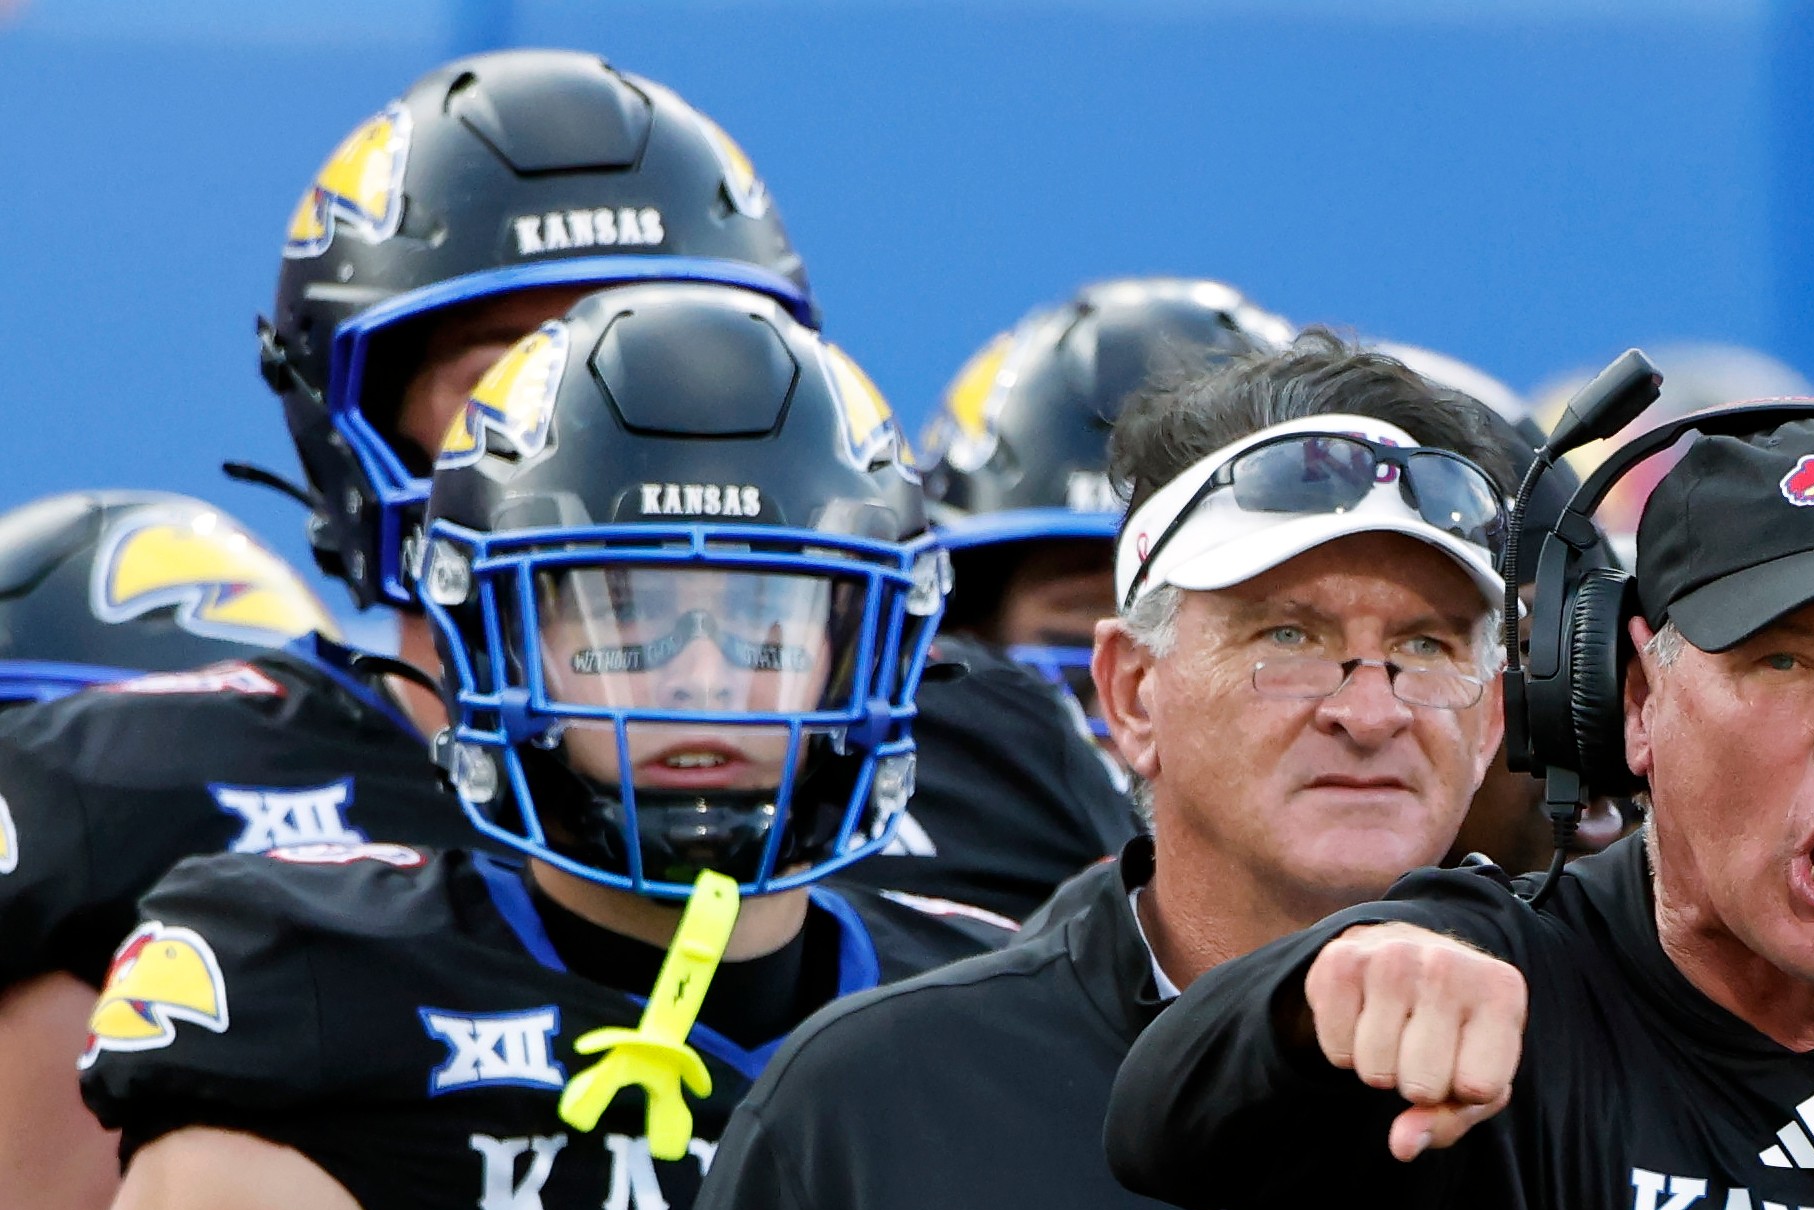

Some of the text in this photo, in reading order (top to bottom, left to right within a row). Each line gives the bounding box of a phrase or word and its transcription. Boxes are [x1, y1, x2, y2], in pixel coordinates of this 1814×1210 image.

[513, 206, 665, 255] KANSAS
[641, 483, 761, 517] KANSAS
[421, 1007, 568, 1094] XII
